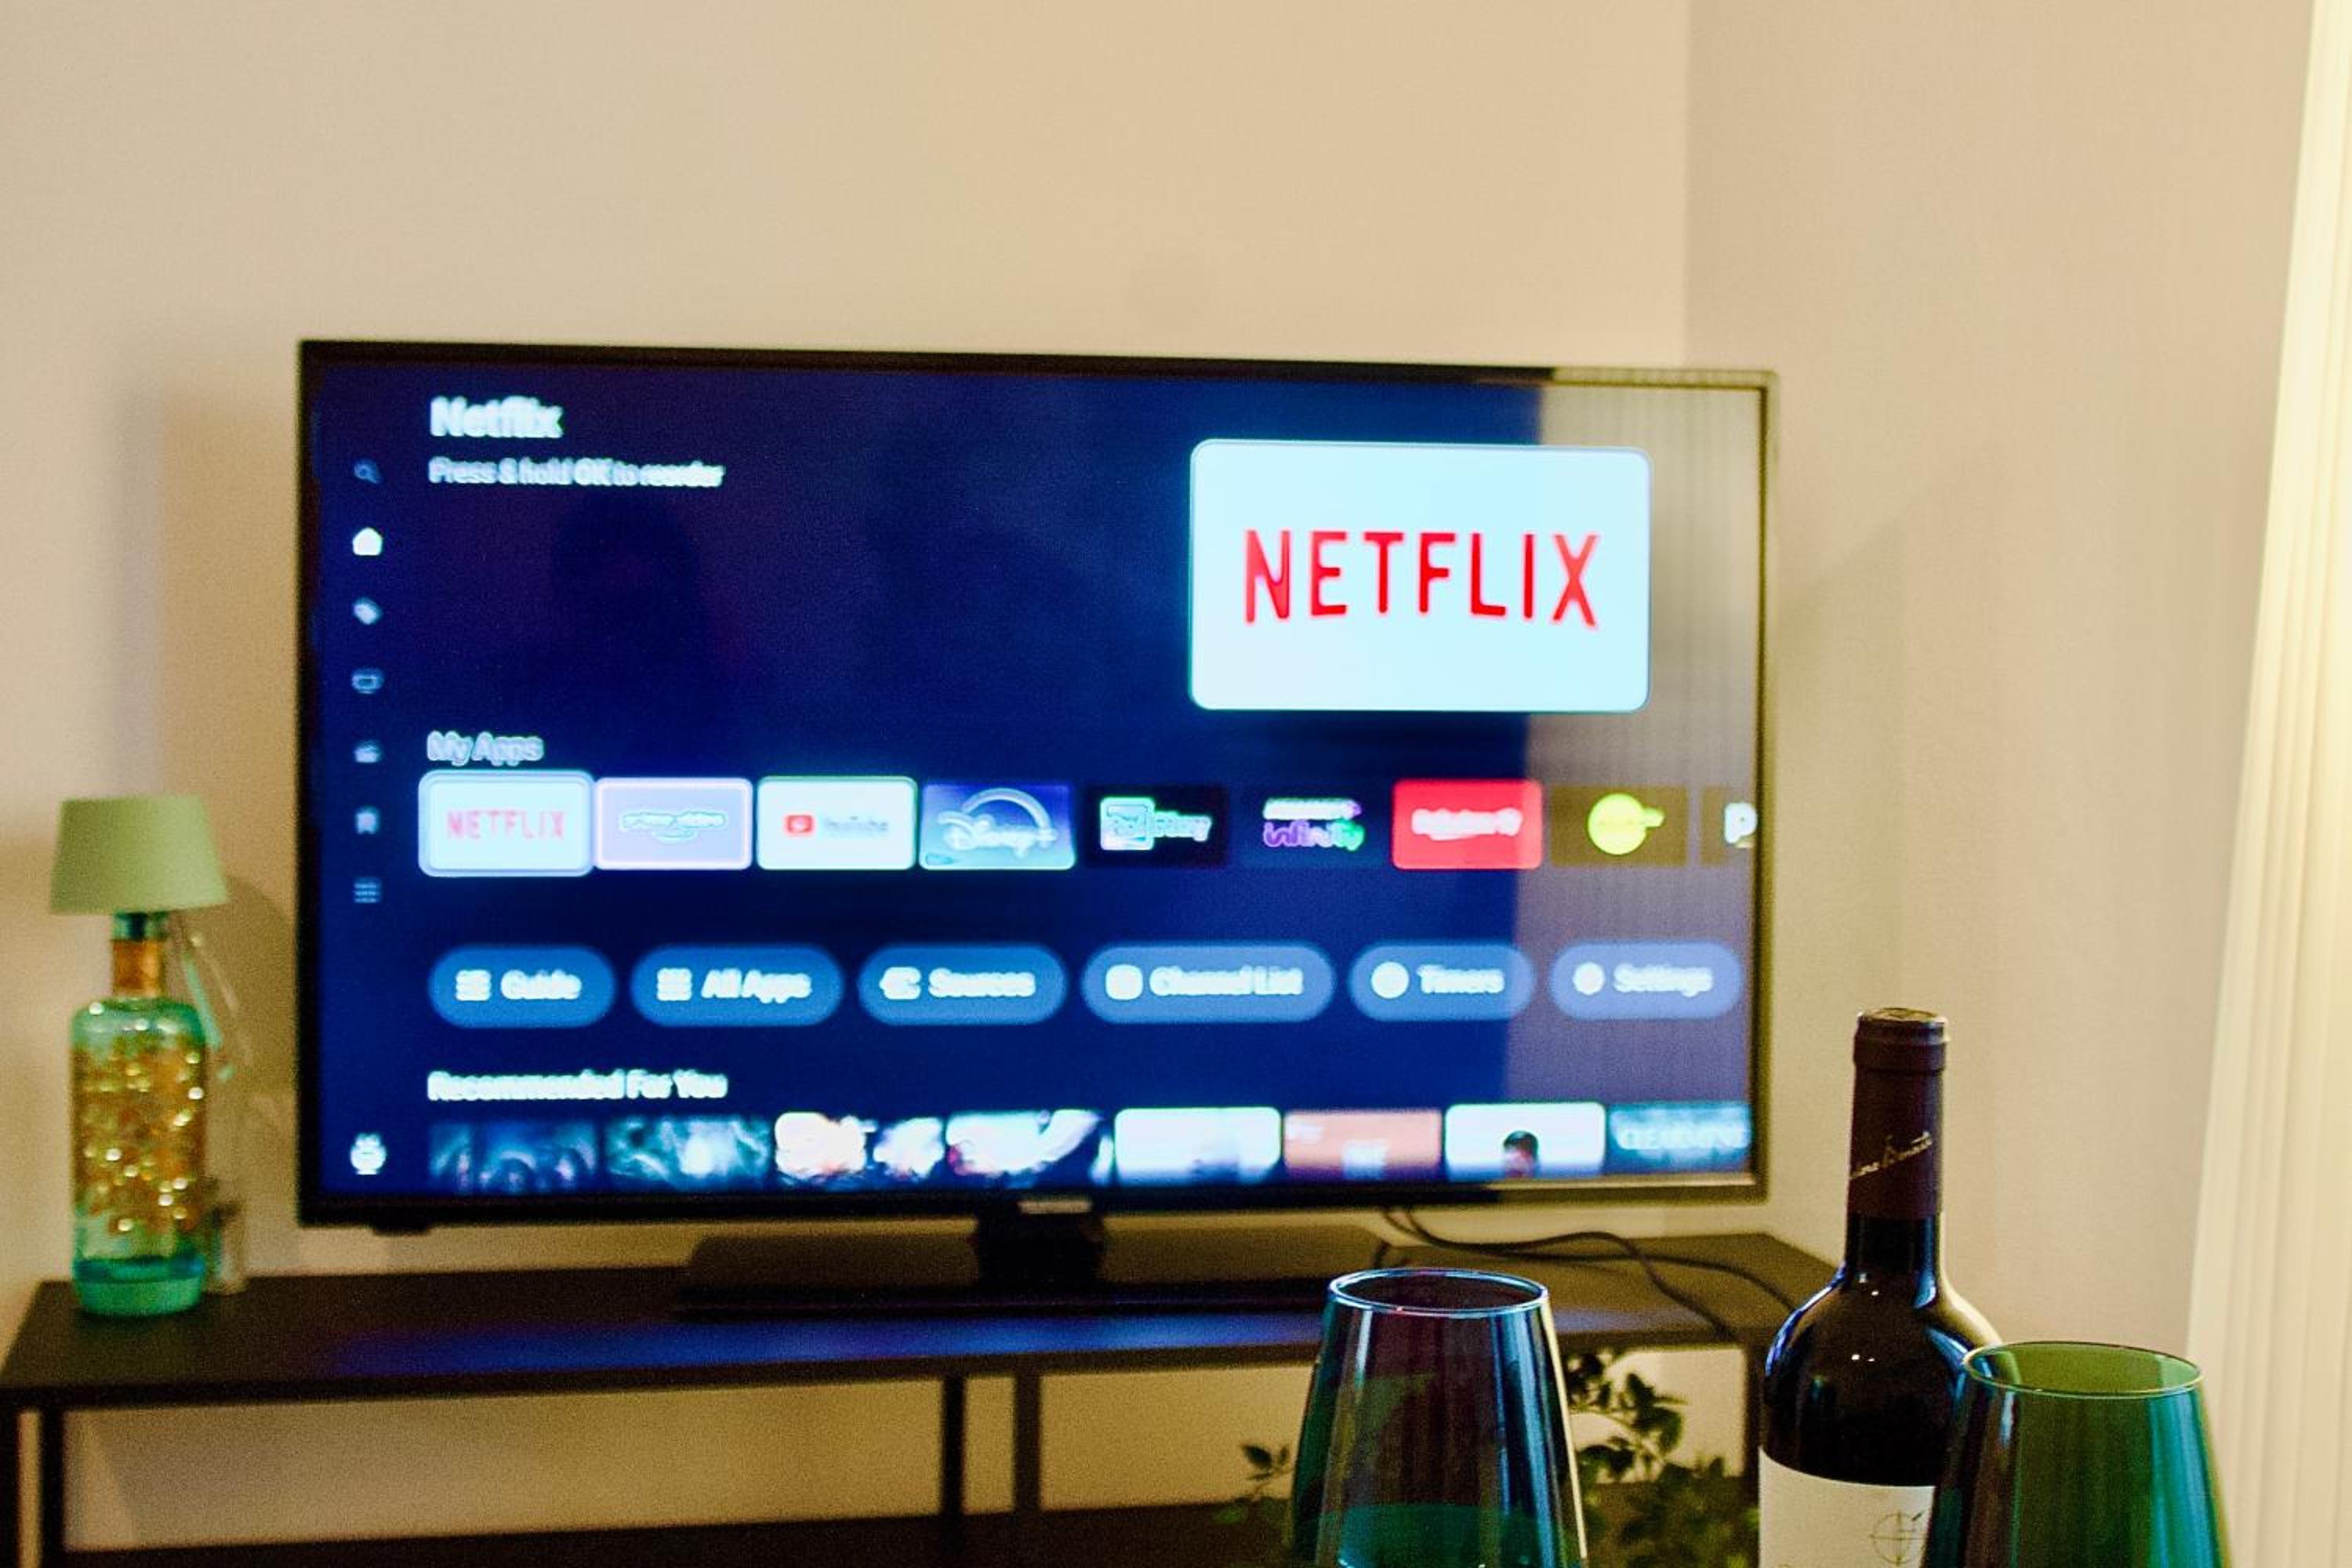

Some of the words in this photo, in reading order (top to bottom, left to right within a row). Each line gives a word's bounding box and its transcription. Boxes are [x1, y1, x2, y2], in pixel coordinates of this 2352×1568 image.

[430, 396, 564, 438] Netflix
[429, 457, 497, 484] Press
[499, 458, 518, 485] &
[519, 458, 572, 485] hold
[573, 459, 612, 485] OK
[613, 462, 639, 485] to
[639, 462, 724, 487] reorder
[1244, 529, 1598, 627] NETFLIX
[427, 731, 473, 766] My
[472, 731, 544, 766] Apps
[447, 808, 564, 839] NETFLIX
[500, 970, 582, 1000] Guide
[702, 969, 742, 998] All
[742, 970, 811, 1003] Apps
[928, 968, 1036, 997] Sources
[1149, 965, 1253, 996] Channel
[1254, 965, 1303, 995] List
[1417, 964, 1504, 993] Timers
[1613, 964, 1713, 996] Settings
[427, 1069, 625, 1101] Recommended
[626, 1069, 673, 1098] For
[673, 1069, 728, 1098] You
